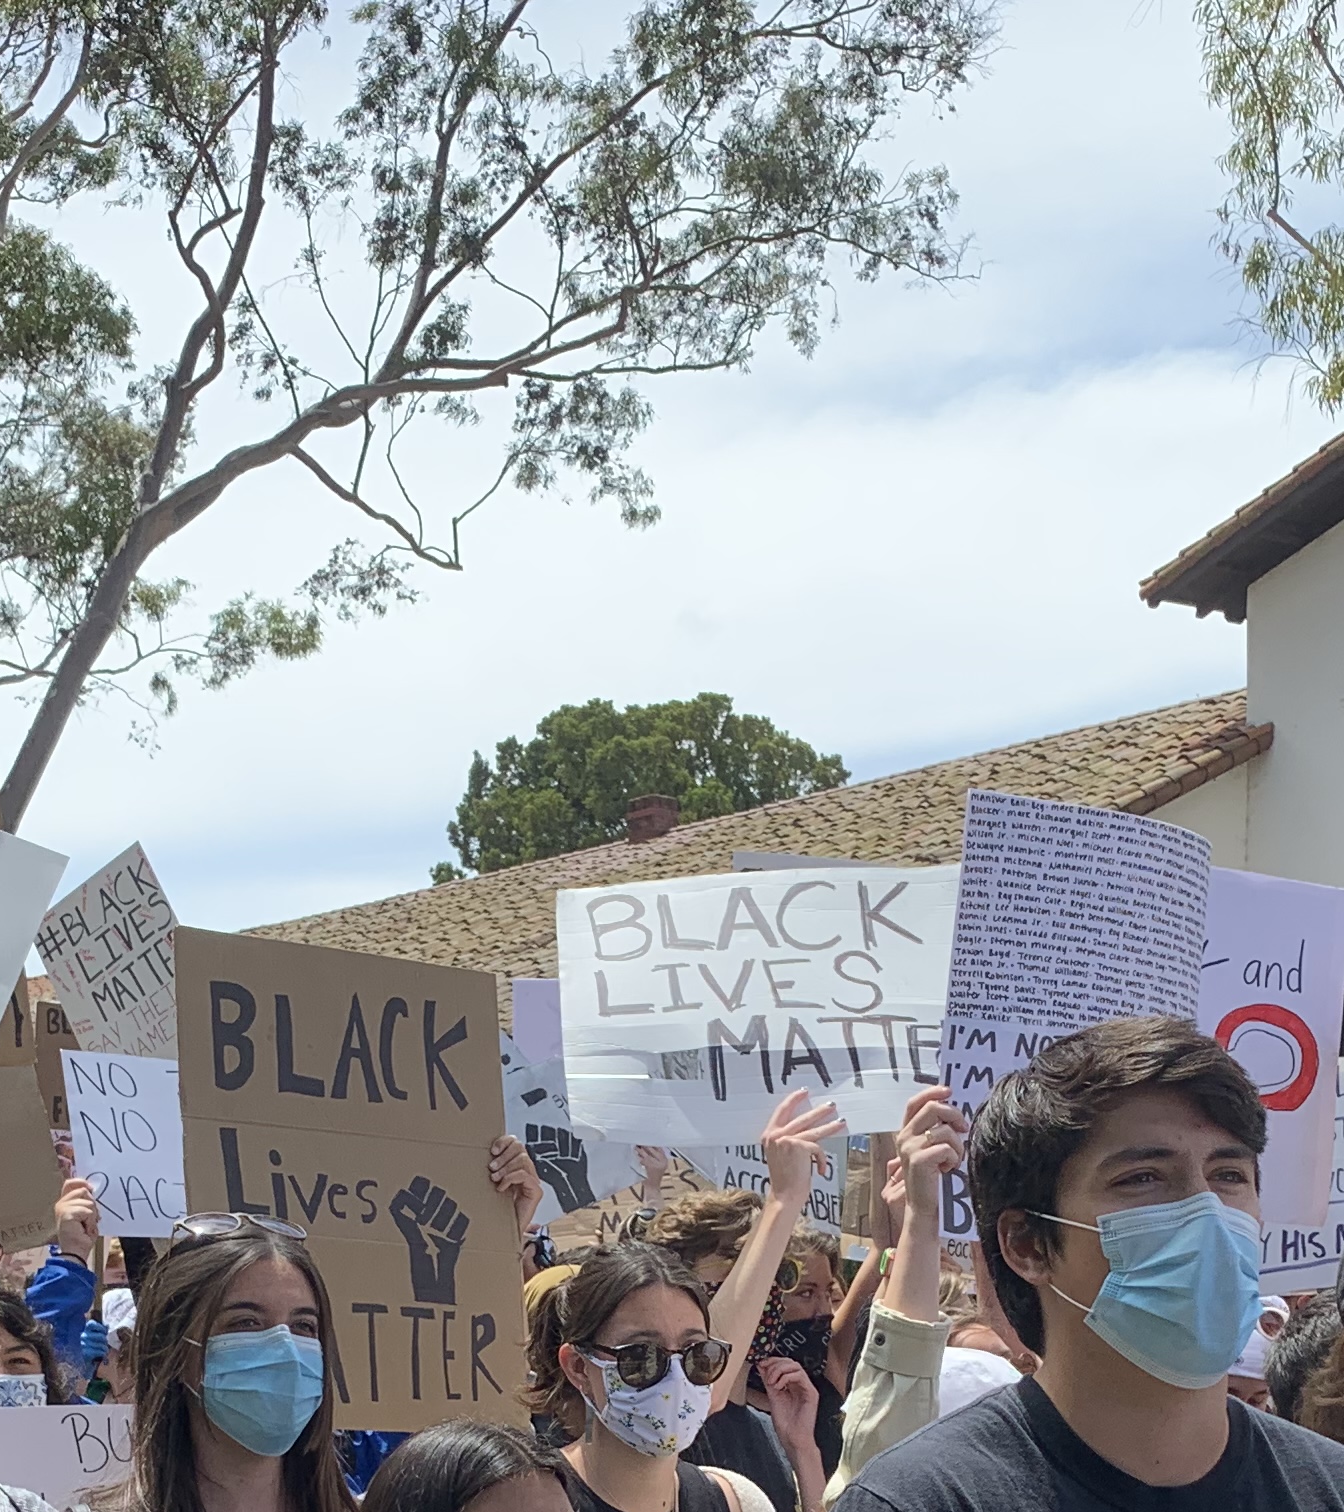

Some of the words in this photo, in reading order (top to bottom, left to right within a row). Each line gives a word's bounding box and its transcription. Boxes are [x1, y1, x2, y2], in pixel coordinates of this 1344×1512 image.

[36, 857, 160, 962] #BLACK
[75, 891, 172, 984] LIVES
[586, 880, 923, 961] BLACK
[92, 934, 174, 1023] MATTE
[596, 950, 884, 1018] LIVES
[1242, 939, 1306, 994] and
[71, 1057, 138, 1099] NO
[210, 981, 470, 1110] BLACK
[708, 1014, 943, 1101] MATTE
[949, 1024, 997, 1053] I'M
[81, 1108, 158, 1155] NO
[220, 1128, 377, 1225] Lives
[1281, 1229, 1327, 1264] HIS
